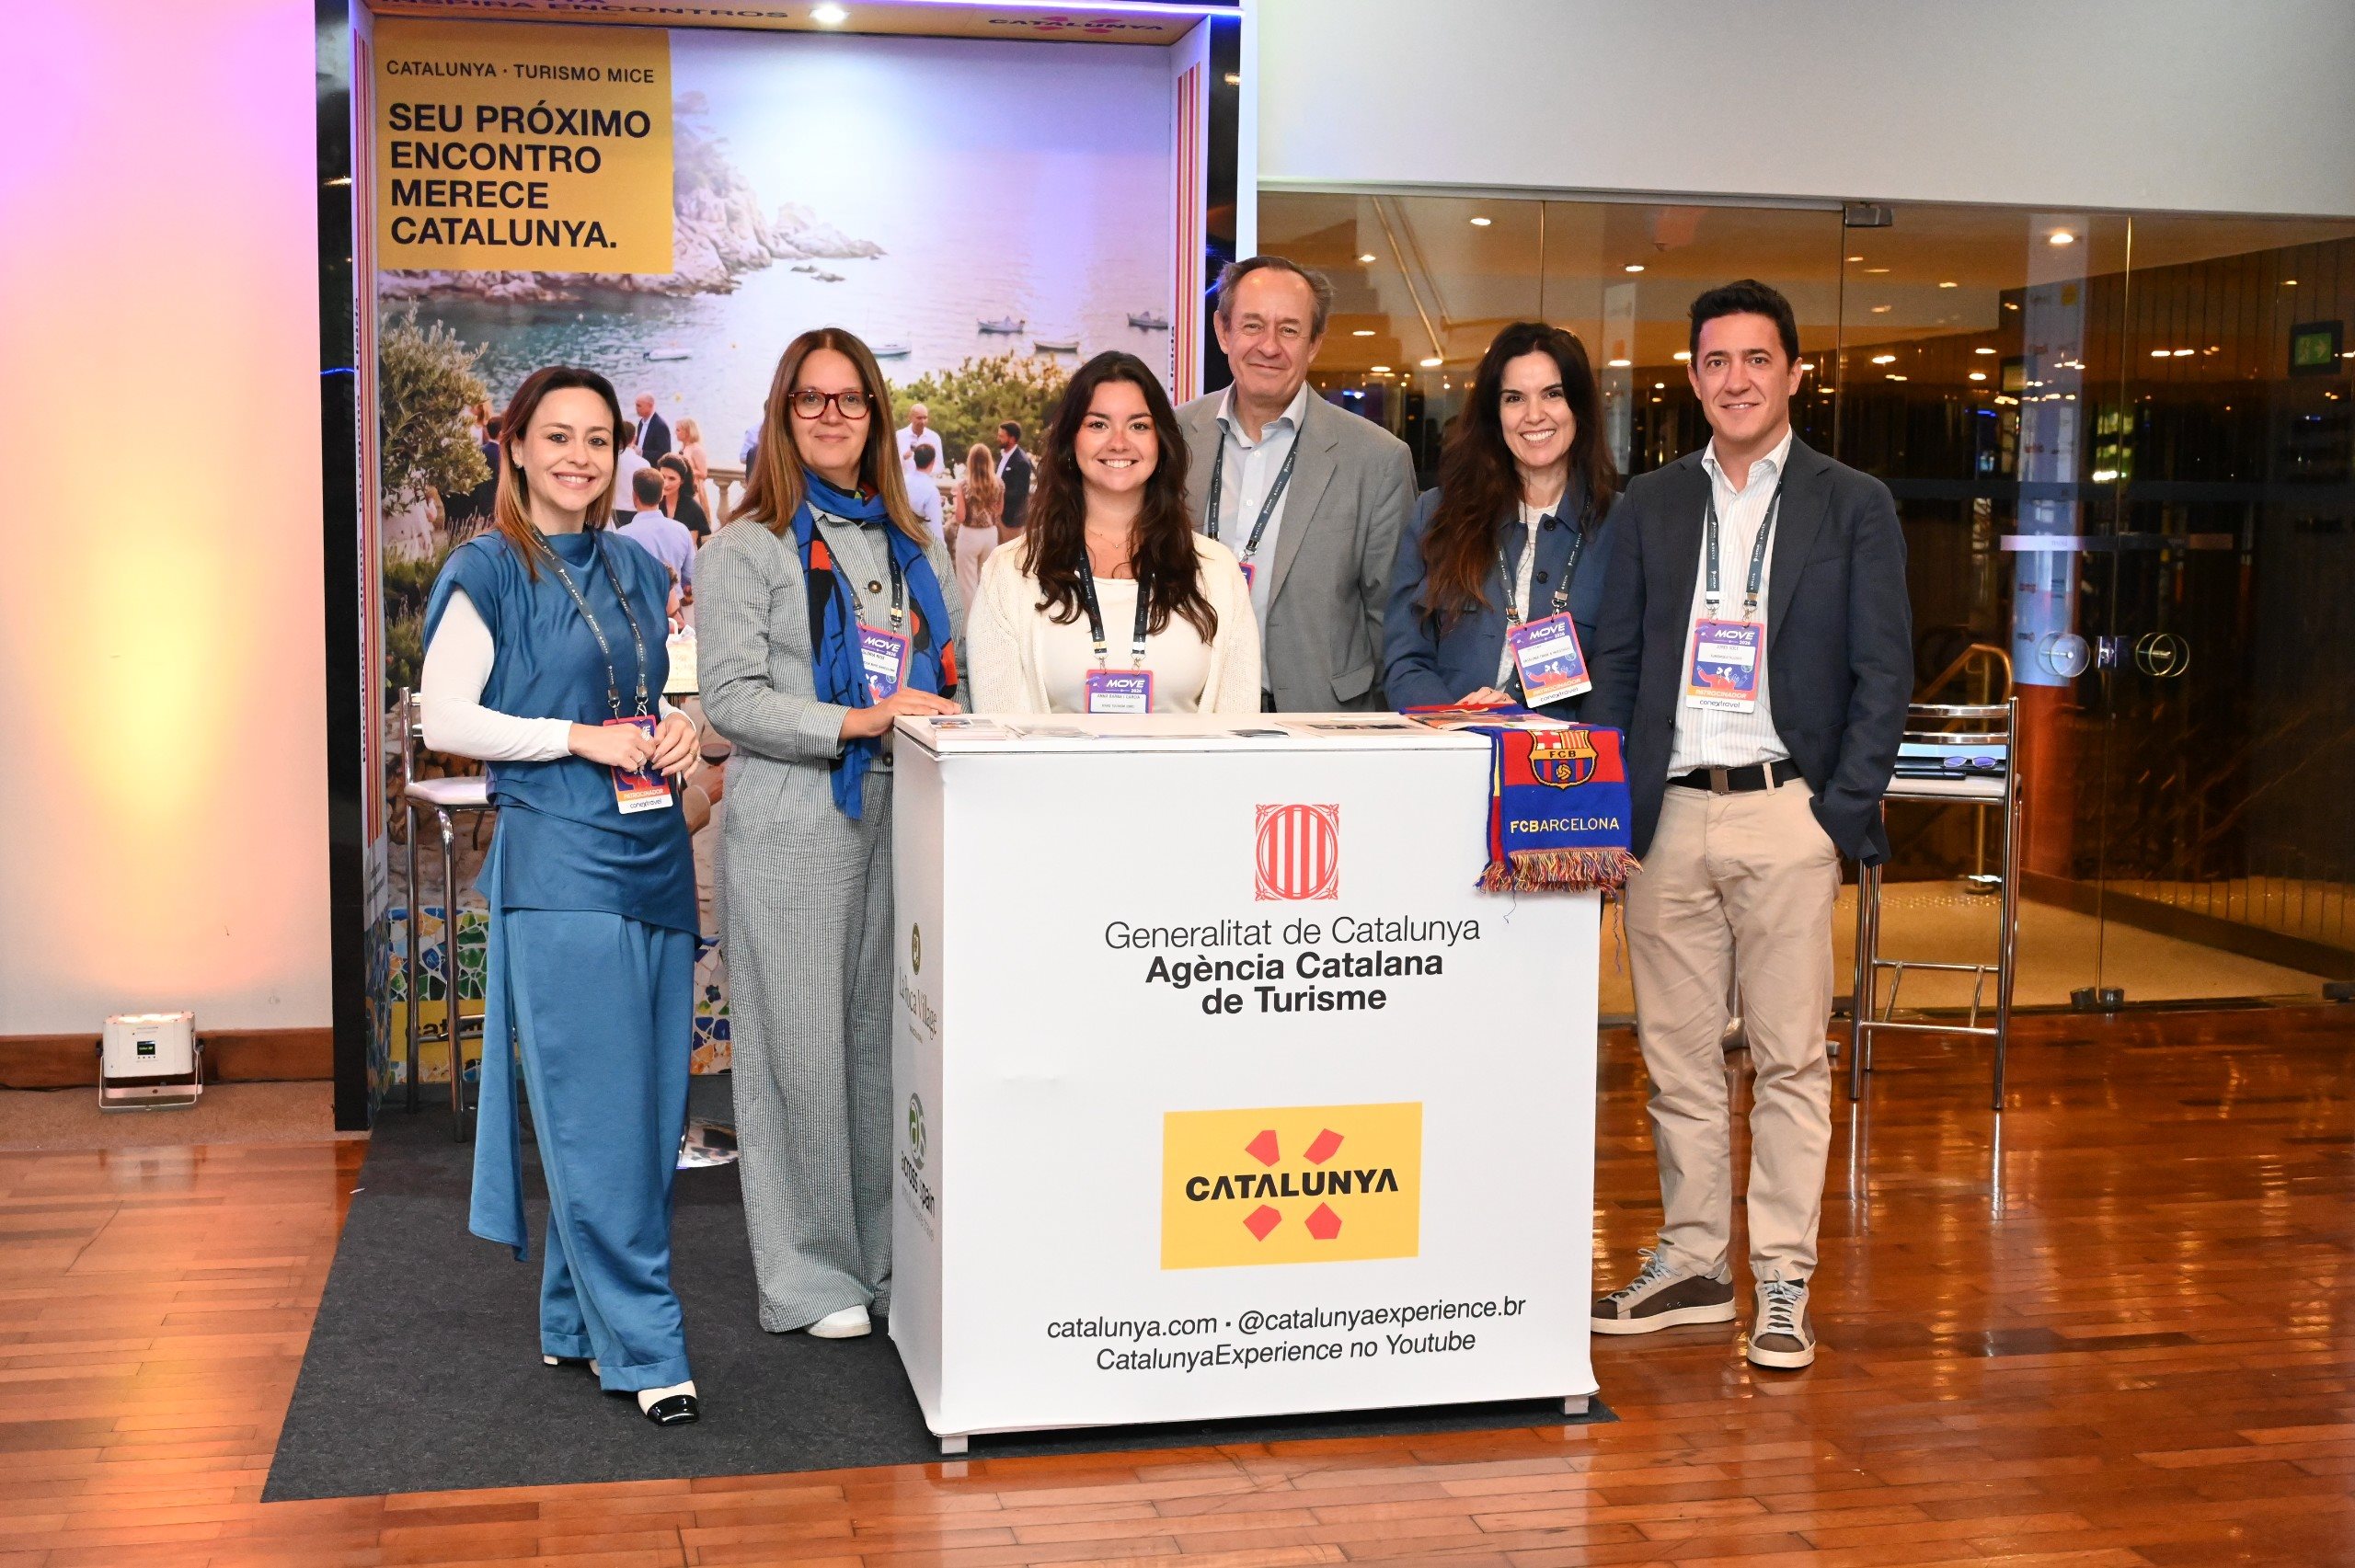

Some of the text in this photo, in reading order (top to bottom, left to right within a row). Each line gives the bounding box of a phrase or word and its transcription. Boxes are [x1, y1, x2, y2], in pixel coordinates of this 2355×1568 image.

[548, 3, 787, 17] ENCONTROS
[988, 19, 1163, 30] CATALUNYA
[386, 60, 497, 77] CATALUNYA
[513, 64, 601, 81] TURISMO
[607, 67, 654, 83] MICE
[389, 100, 651, 138] SEU PRÓXIMO
[391, 141, 602, 174] ENCONTRO
[391, 179, 549, 209] MERECE
[391, 216, 617, 248] CATALUNYA.
[1530, 623, 1566, 640] MOVE
[1715, 630, 1755, 640] MOVE
[865, 636, 902, 653] MOVE
[1106, 680, 1145, 688] MOVE
[1695, 689, 1747, 699] PATROCINADOR
[1699, 700, 1740, 708] conextravel
[1549, 750, 1577, 759] FCB
[624, 788, 664, 798] PATROCINADOR
[630, 798, 662, 808] conextravel
[1511, 818, 1619, 833] FCBARCELONA
[1105, 916, 1479, 949] Generalitat de Catalunya
[1146, 950, 1443, 989] Agència Catalana
[1201, 984, 1386, 1014] de Turisme
[1186, 1168, 1398, 1202] CATALUNYA
[1047, 1313, 1218, 1343] catalunya.com
[1238, 1296, 1526, 1336] @catalunyaexperience.br
[1096, 1330, 1476, 1373] CatalunyaExperience no Youtube
